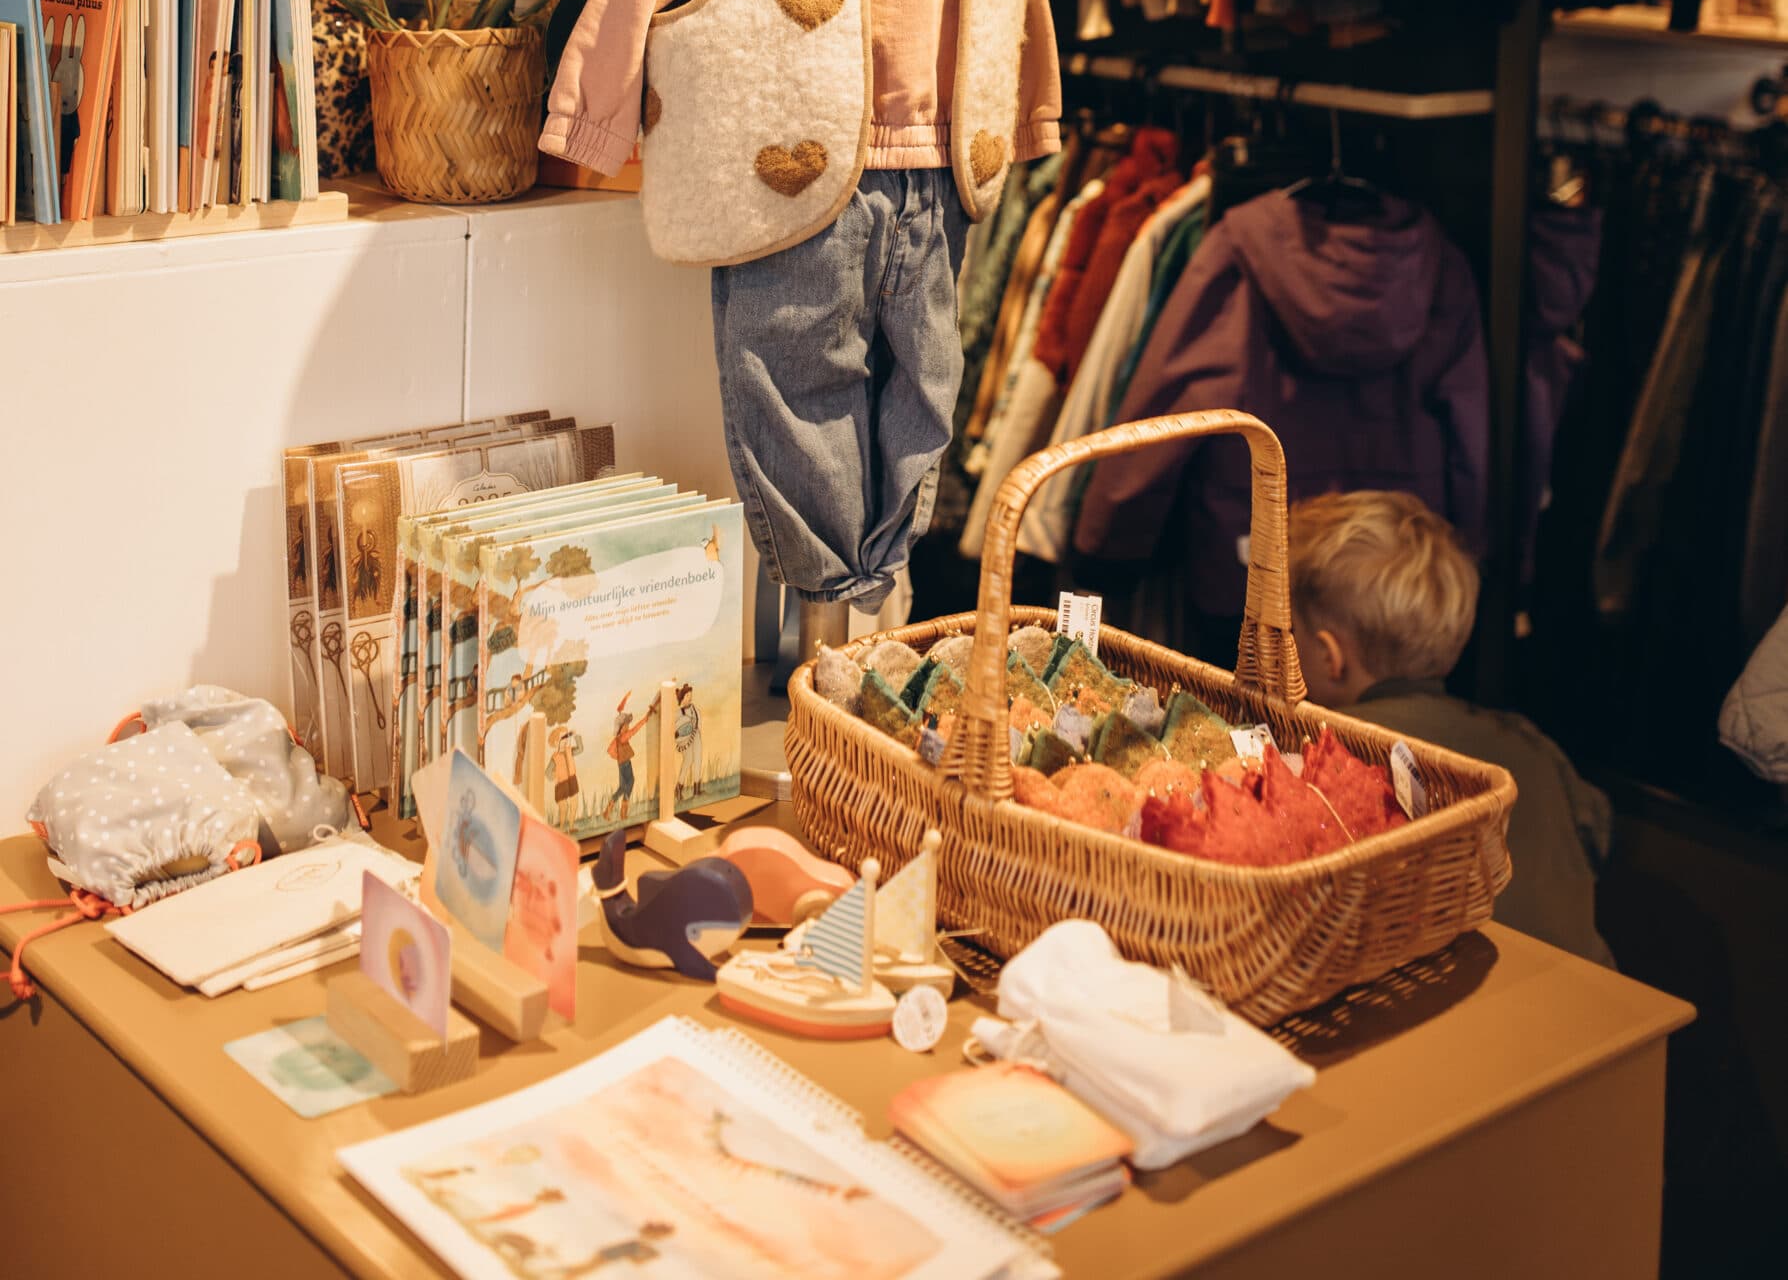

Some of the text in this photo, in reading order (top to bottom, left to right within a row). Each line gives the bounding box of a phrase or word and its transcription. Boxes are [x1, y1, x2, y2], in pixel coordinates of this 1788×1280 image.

[529, 568, 716, 620] Mijn avontuurlijke vriendenboek
[1089, 604, 1097, 626] Circus
